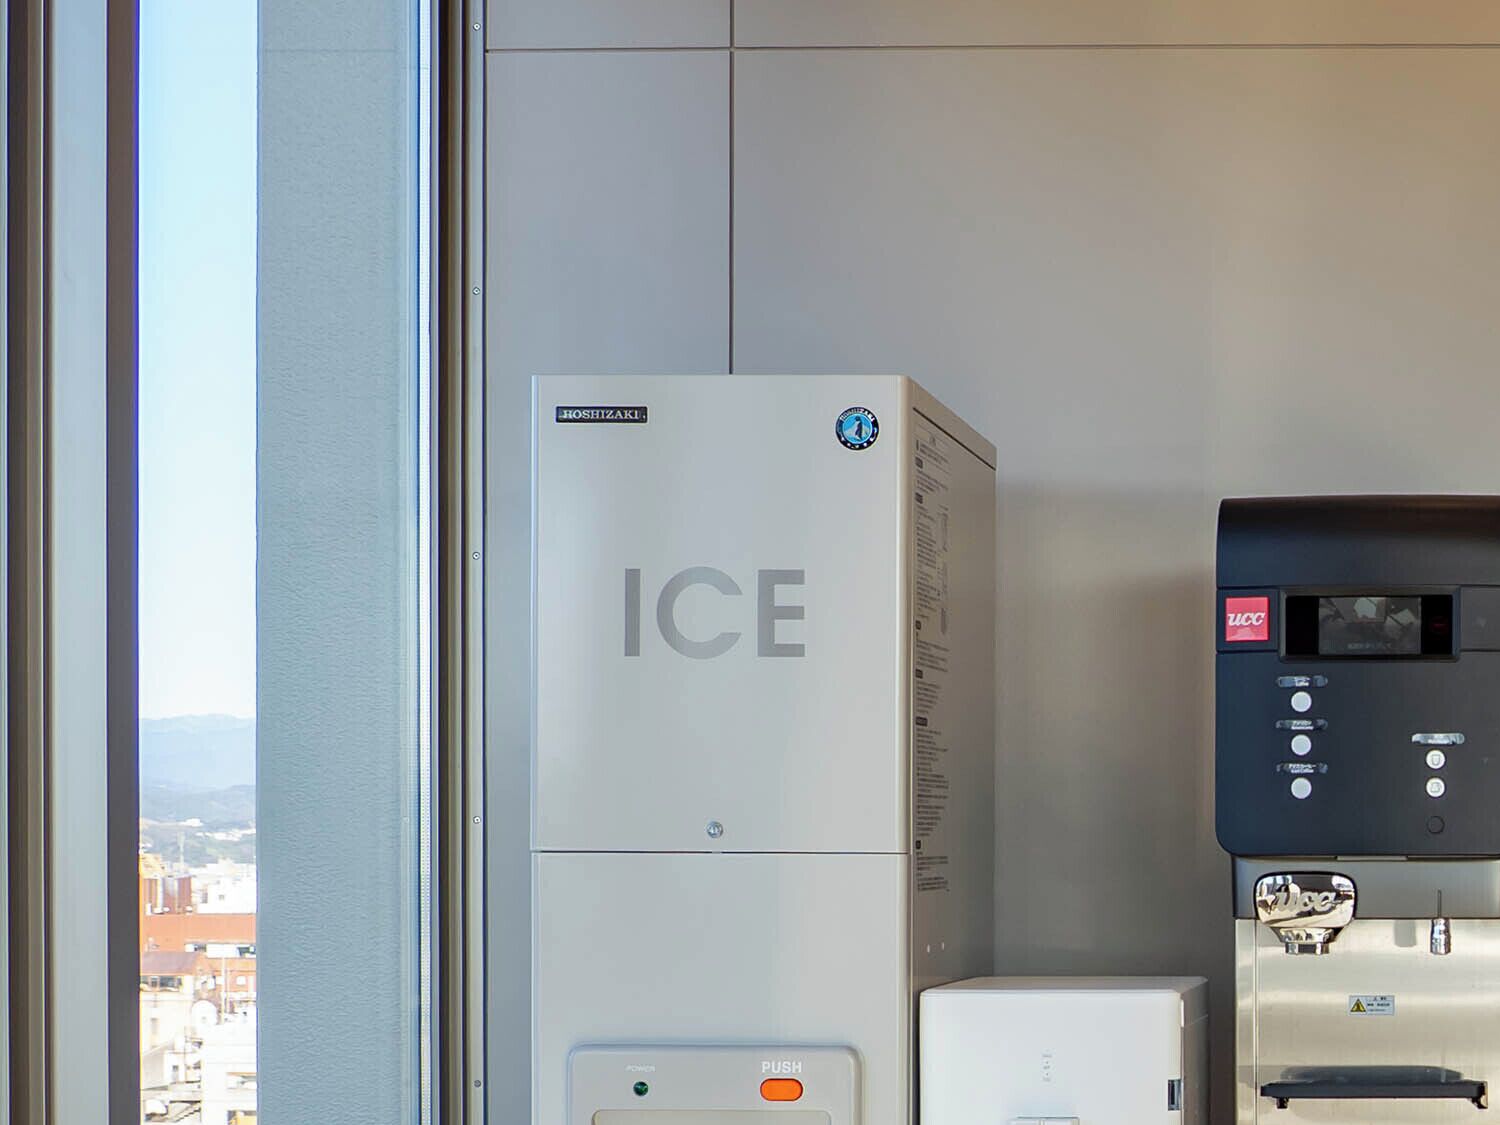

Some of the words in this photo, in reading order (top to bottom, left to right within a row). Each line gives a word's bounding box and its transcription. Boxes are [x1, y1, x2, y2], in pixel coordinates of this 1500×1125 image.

[562, 409, 640, 419] HOSHIZAKI
[624, 566, 806, 660] ICE
[761, 1061, 802, 1073] PUSH
